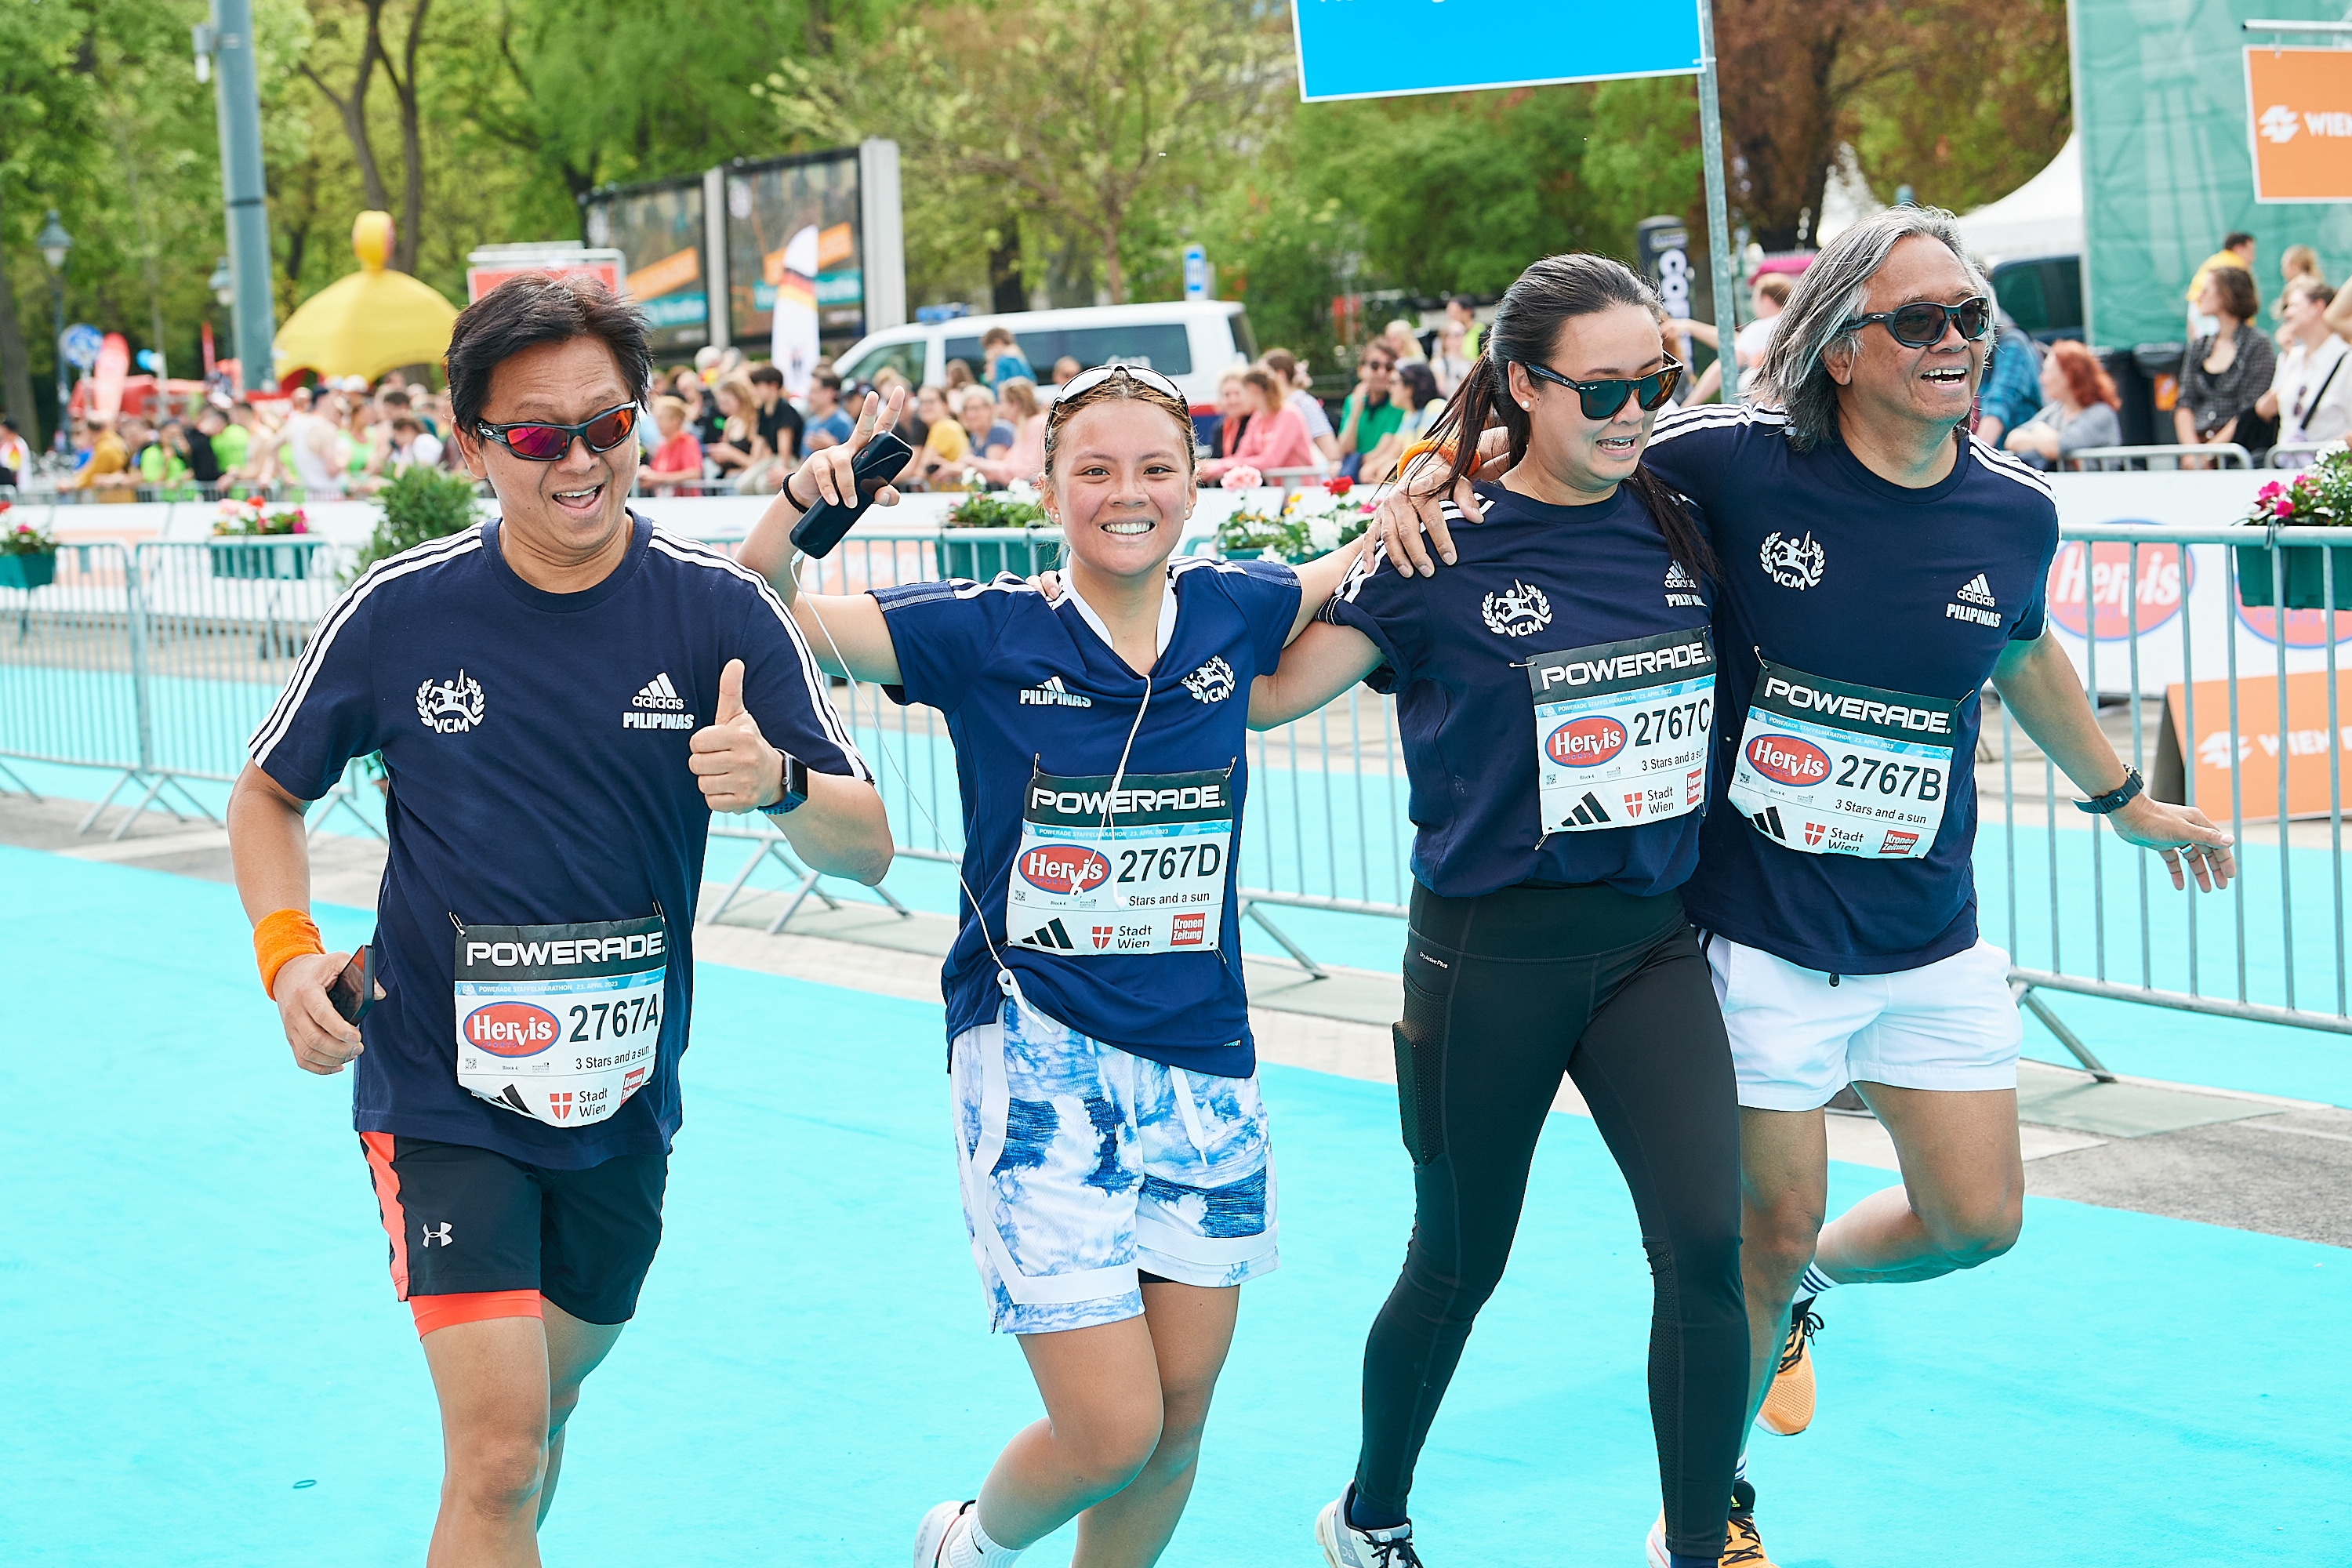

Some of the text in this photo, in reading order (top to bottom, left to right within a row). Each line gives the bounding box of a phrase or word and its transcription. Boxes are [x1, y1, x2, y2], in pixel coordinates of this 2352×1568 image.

[1664, 578, 1697, 588] adids
[1773, 569, 1806, 591] VCM
[1956, 589, 1996, 608] adidas
[1945, 602, 2002, 628] PILIPINAS
[1504, 619, 1544, 637] VCM
[1540, 641, 1704, 691] POWERADE
[632, 695, 684, 710] adidas
[1019, 689, 1092, 708] PILIPINAS
[1201, 685, 1229, 704] VCM
[1558, 702, 1587, 712] POWERADE
[1588, 695, 1636, 709] STAFFELMARATHON
[1764, 677, 1950, 734] POWERADE
[434, 718, 470, 734] VCM
[622, 712, 695, 730] PILIPINAS
[1633, 698, 1711, 747] 2767C
[1769, 716, 1798, 729] POWERADE
[1799, 724, 1852, 741] STAFFELMARATHON
[1554, 727, 1621, 756] Hervis
[1561, 752, 1593, 762] SPORTS
[1642, 760, 1648, 771] 3
[1650, 758, 1673, 770] Stars
[1675, 751, 1689, 765] and
[1690, 752, 1695, 760] a
[1753, 739, 1824, 777] Hervis
[1758, 763, 1790, 777] SPORTS
[1835, 754, 1941, 801] 2767B
[1031, 785, 1221, 815] POWERADE
[1647, 786, 1673, 801] Stadt
[1649, 801, 1674, 815] Wien
[1835, 799, 1926, 824] 3 Stars and a sun
[1039, 828, 1072, 837] POWERADE
[1830, 827, 1864, 843] Stadt
[1885, 833, 1916, 844] Kronen
[1828, 839, 1860, 853] Wien
[1882, 843, 1911, 851] Zeitung
[1028, 852, 1104, 884] Hervis
[1117, 844, 1221, 883] 2767D
[1033, 877, 1069, 885] SPORTS
[1129, 895, 1156, 906] Stars
[1159, 892, 1178, 904] and
[1190, 891, 1210, 902] sun
[1119, 924, 1152, 936] Stadt
[1174, 917, 1203, 930] Kronen
[1118, 938, 1150, 949] Wien
[1173, 928, 1203, 942] Zeitung
[466, 931, 663, 967] POWERADE
[569, 993, 659, 1043] 2767A
[473, 1014, 553, 1046] Hervis
[575, 1046, 650, 1070] 3 Stars and a sun
[579, 1087, 608, 1103] Stadt
[579, 1104, 606, 1118] Wien
